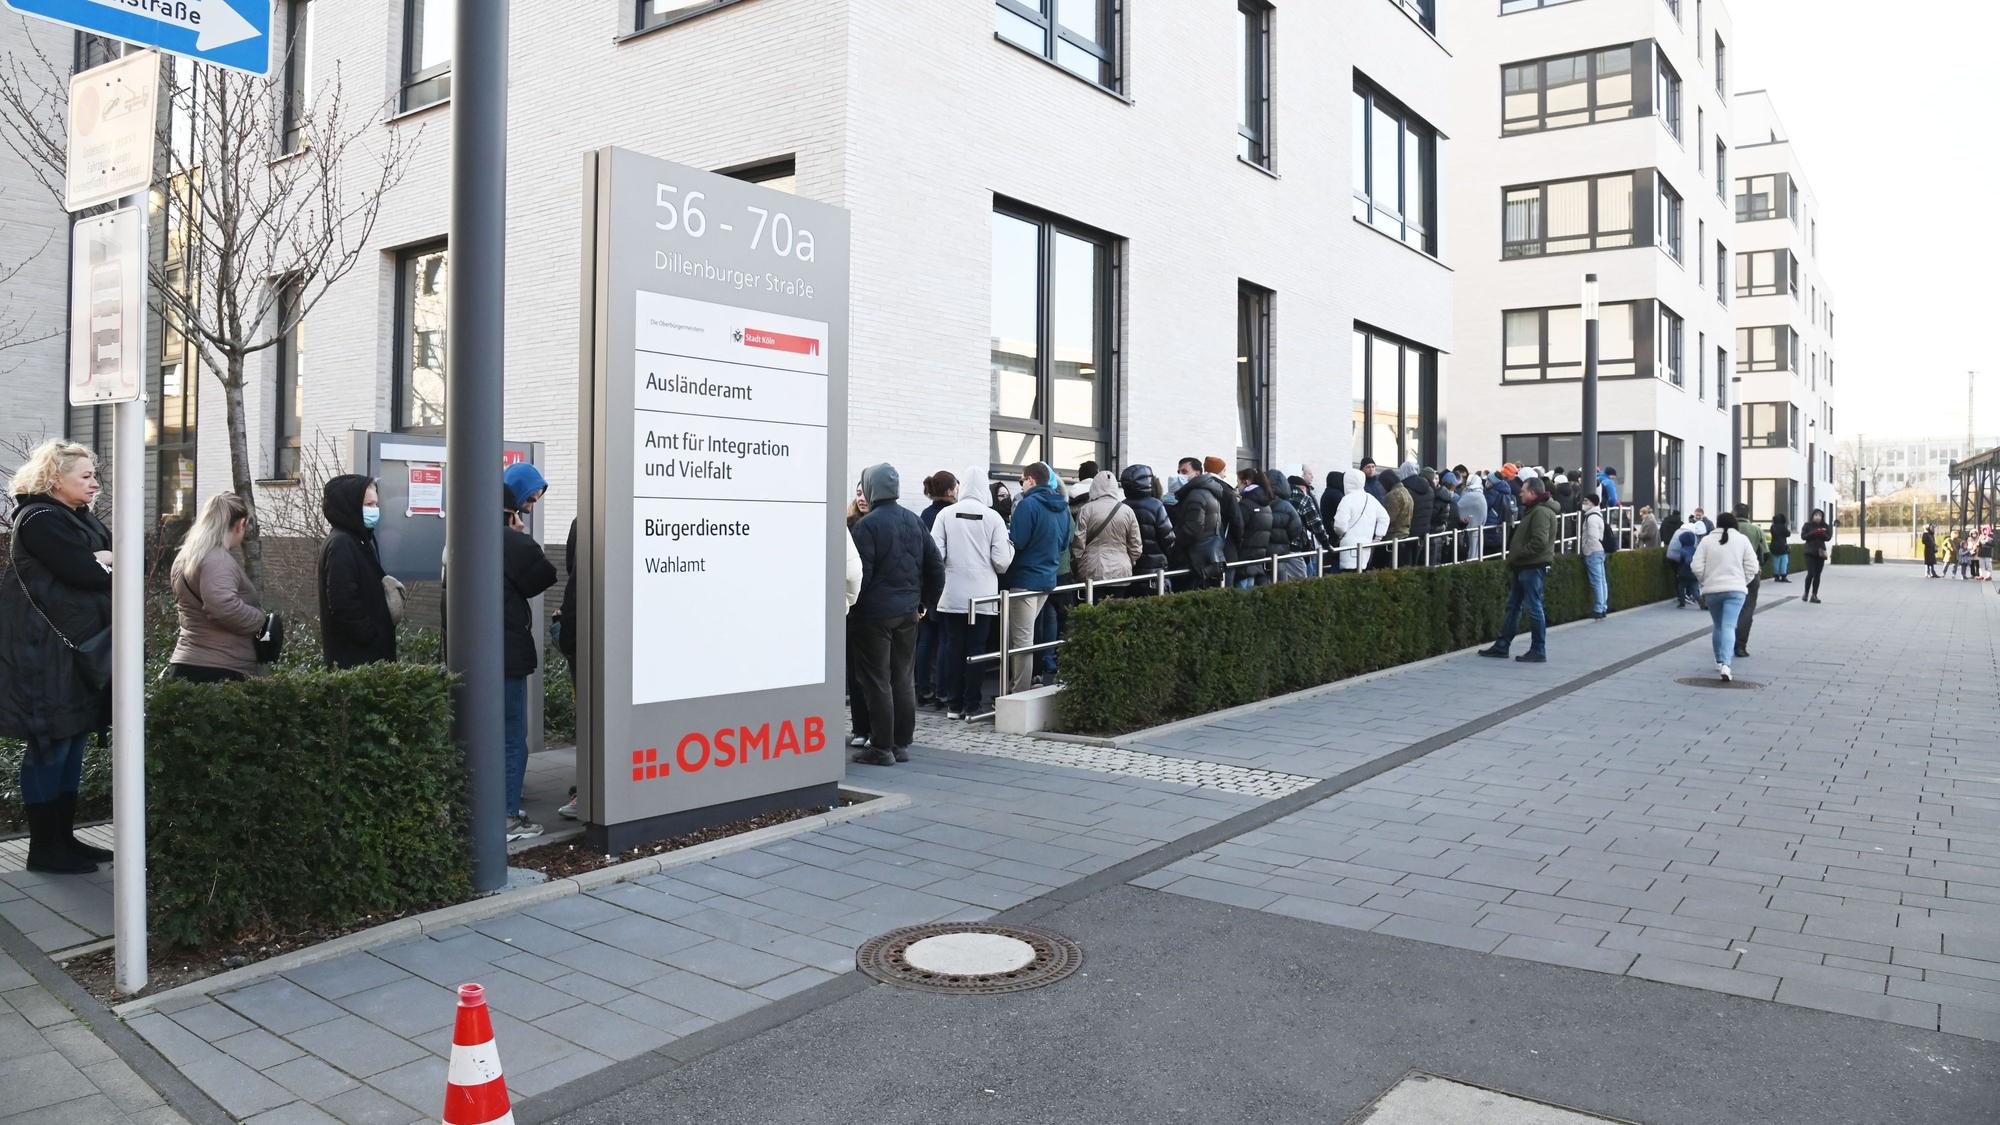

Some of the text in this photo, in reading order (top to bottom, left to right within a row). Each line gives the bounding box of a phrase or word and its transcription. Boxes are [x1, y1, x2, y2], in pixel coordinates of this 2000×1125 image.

[655, 182, 706, 238] 56
[747, 205, 815, 263] 70a
[655, 249, 815, 299] Dillenburger Straße
[745, 333, 776, 345] Stadt Köln
[646, 372, 753, 400] Ausländeramt
[645, 430, 790, 459] Amt für Integration
[645, 458, 733, 480] und Vielfalt
[645, 518, 750, 541] Bürgerdienste
[645, 556, 706, 573] Wahlamt
[676, 715, 826, 773] OSMAB
